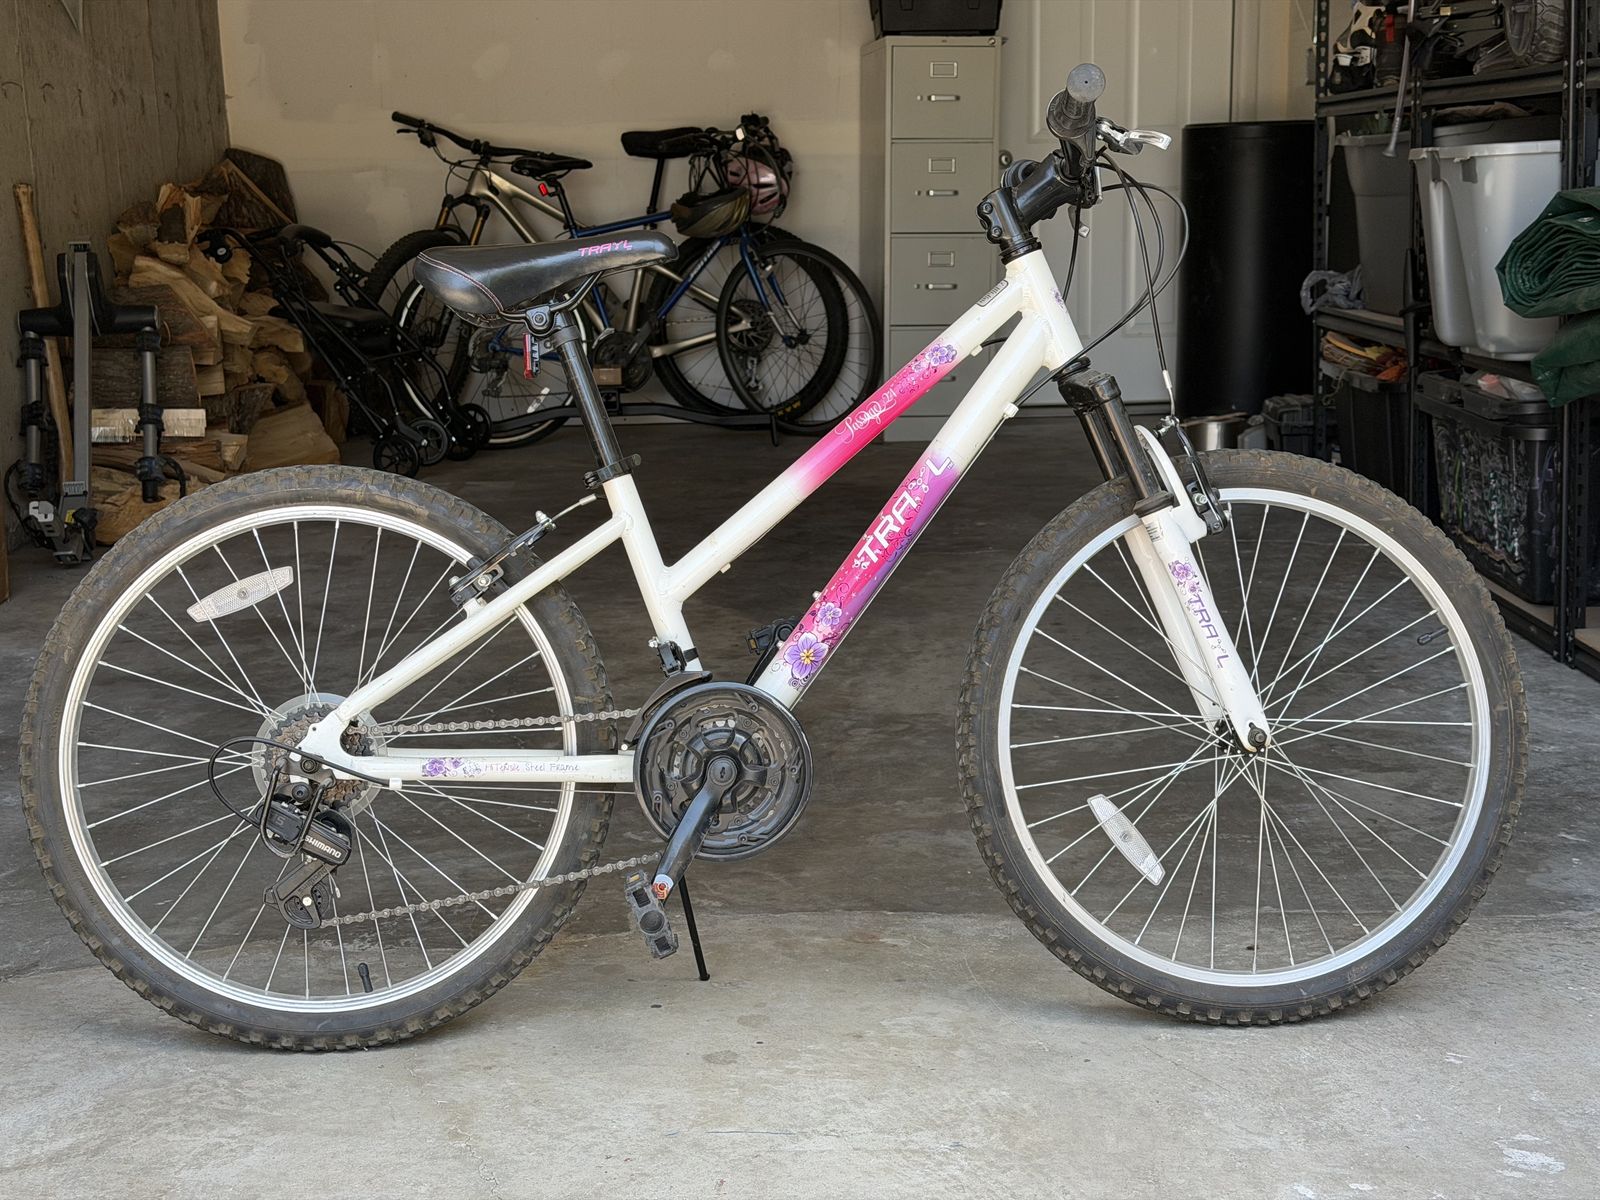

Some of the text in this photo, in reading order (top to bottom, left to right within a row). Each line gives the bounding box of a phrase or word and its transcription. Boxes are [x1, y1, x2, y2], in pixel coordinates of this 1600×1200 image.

[578, 240, 632, 256] TRAYL
[525, 763, 545, 772] Steel
[550, 763, 580, 772] Frame
[304, 834, 342, 859] SHIMANO
